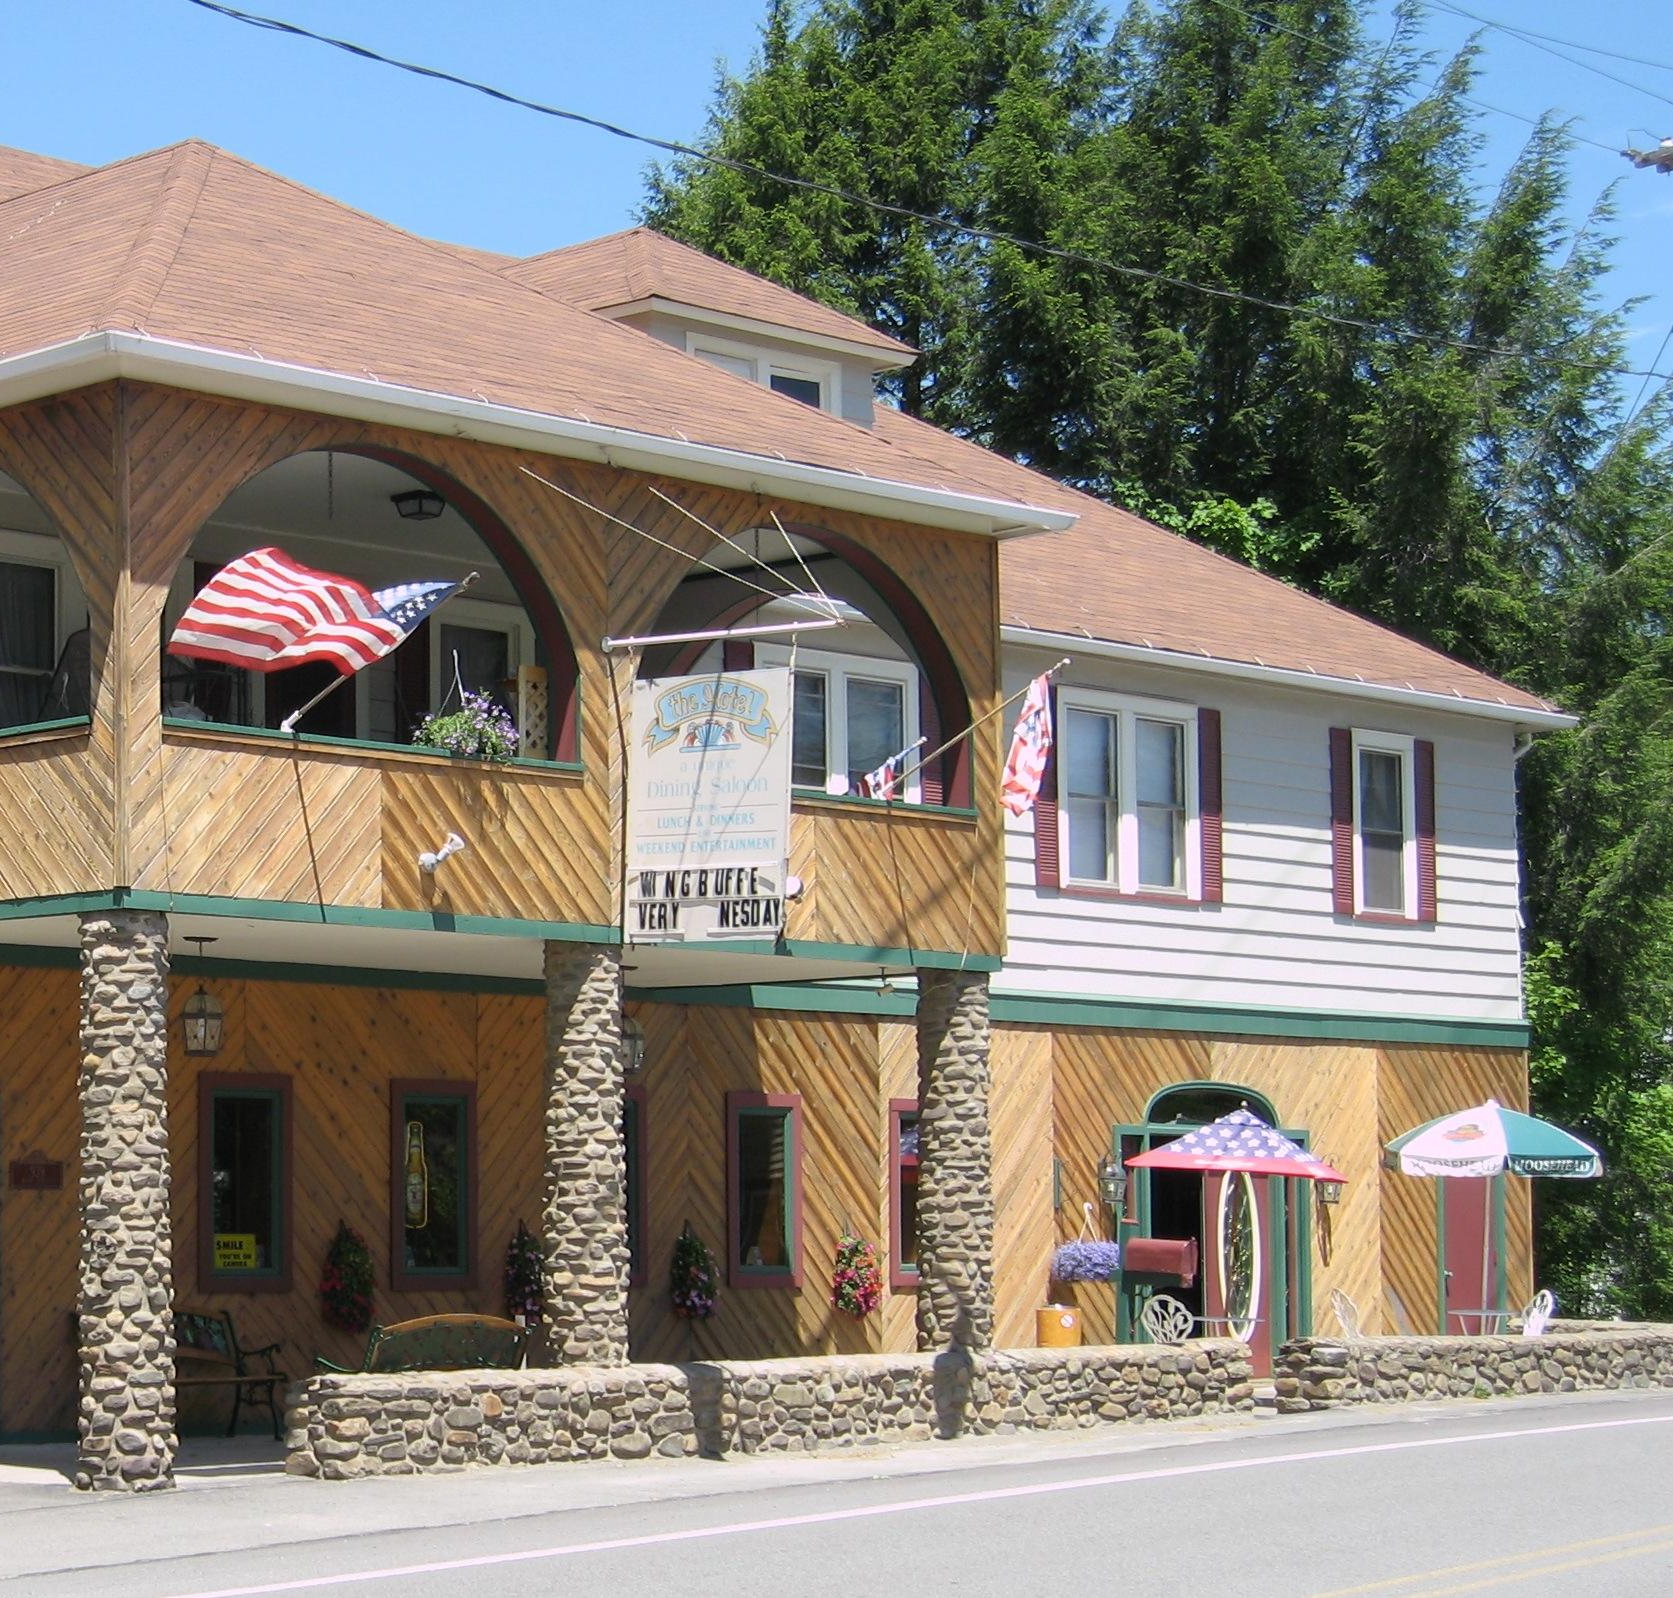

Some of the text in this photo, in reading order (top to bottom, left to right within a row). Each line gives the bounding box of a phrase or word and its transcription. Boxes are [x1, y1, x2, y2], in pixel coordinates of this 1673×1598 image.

[668, 683, 756, 717] the Hotel
[647, 775, 768, 799] Dining Saloon
[657, 816, 692, 829] LUNCH
[710, 813, 755, 827] DINNERS
[636, 837, 777, 856] WEEKEND ENTERTAINMENT
[639, 898, 783, 930] VERY NESDAY
[216, 1240, 244, 1250] SMILE
